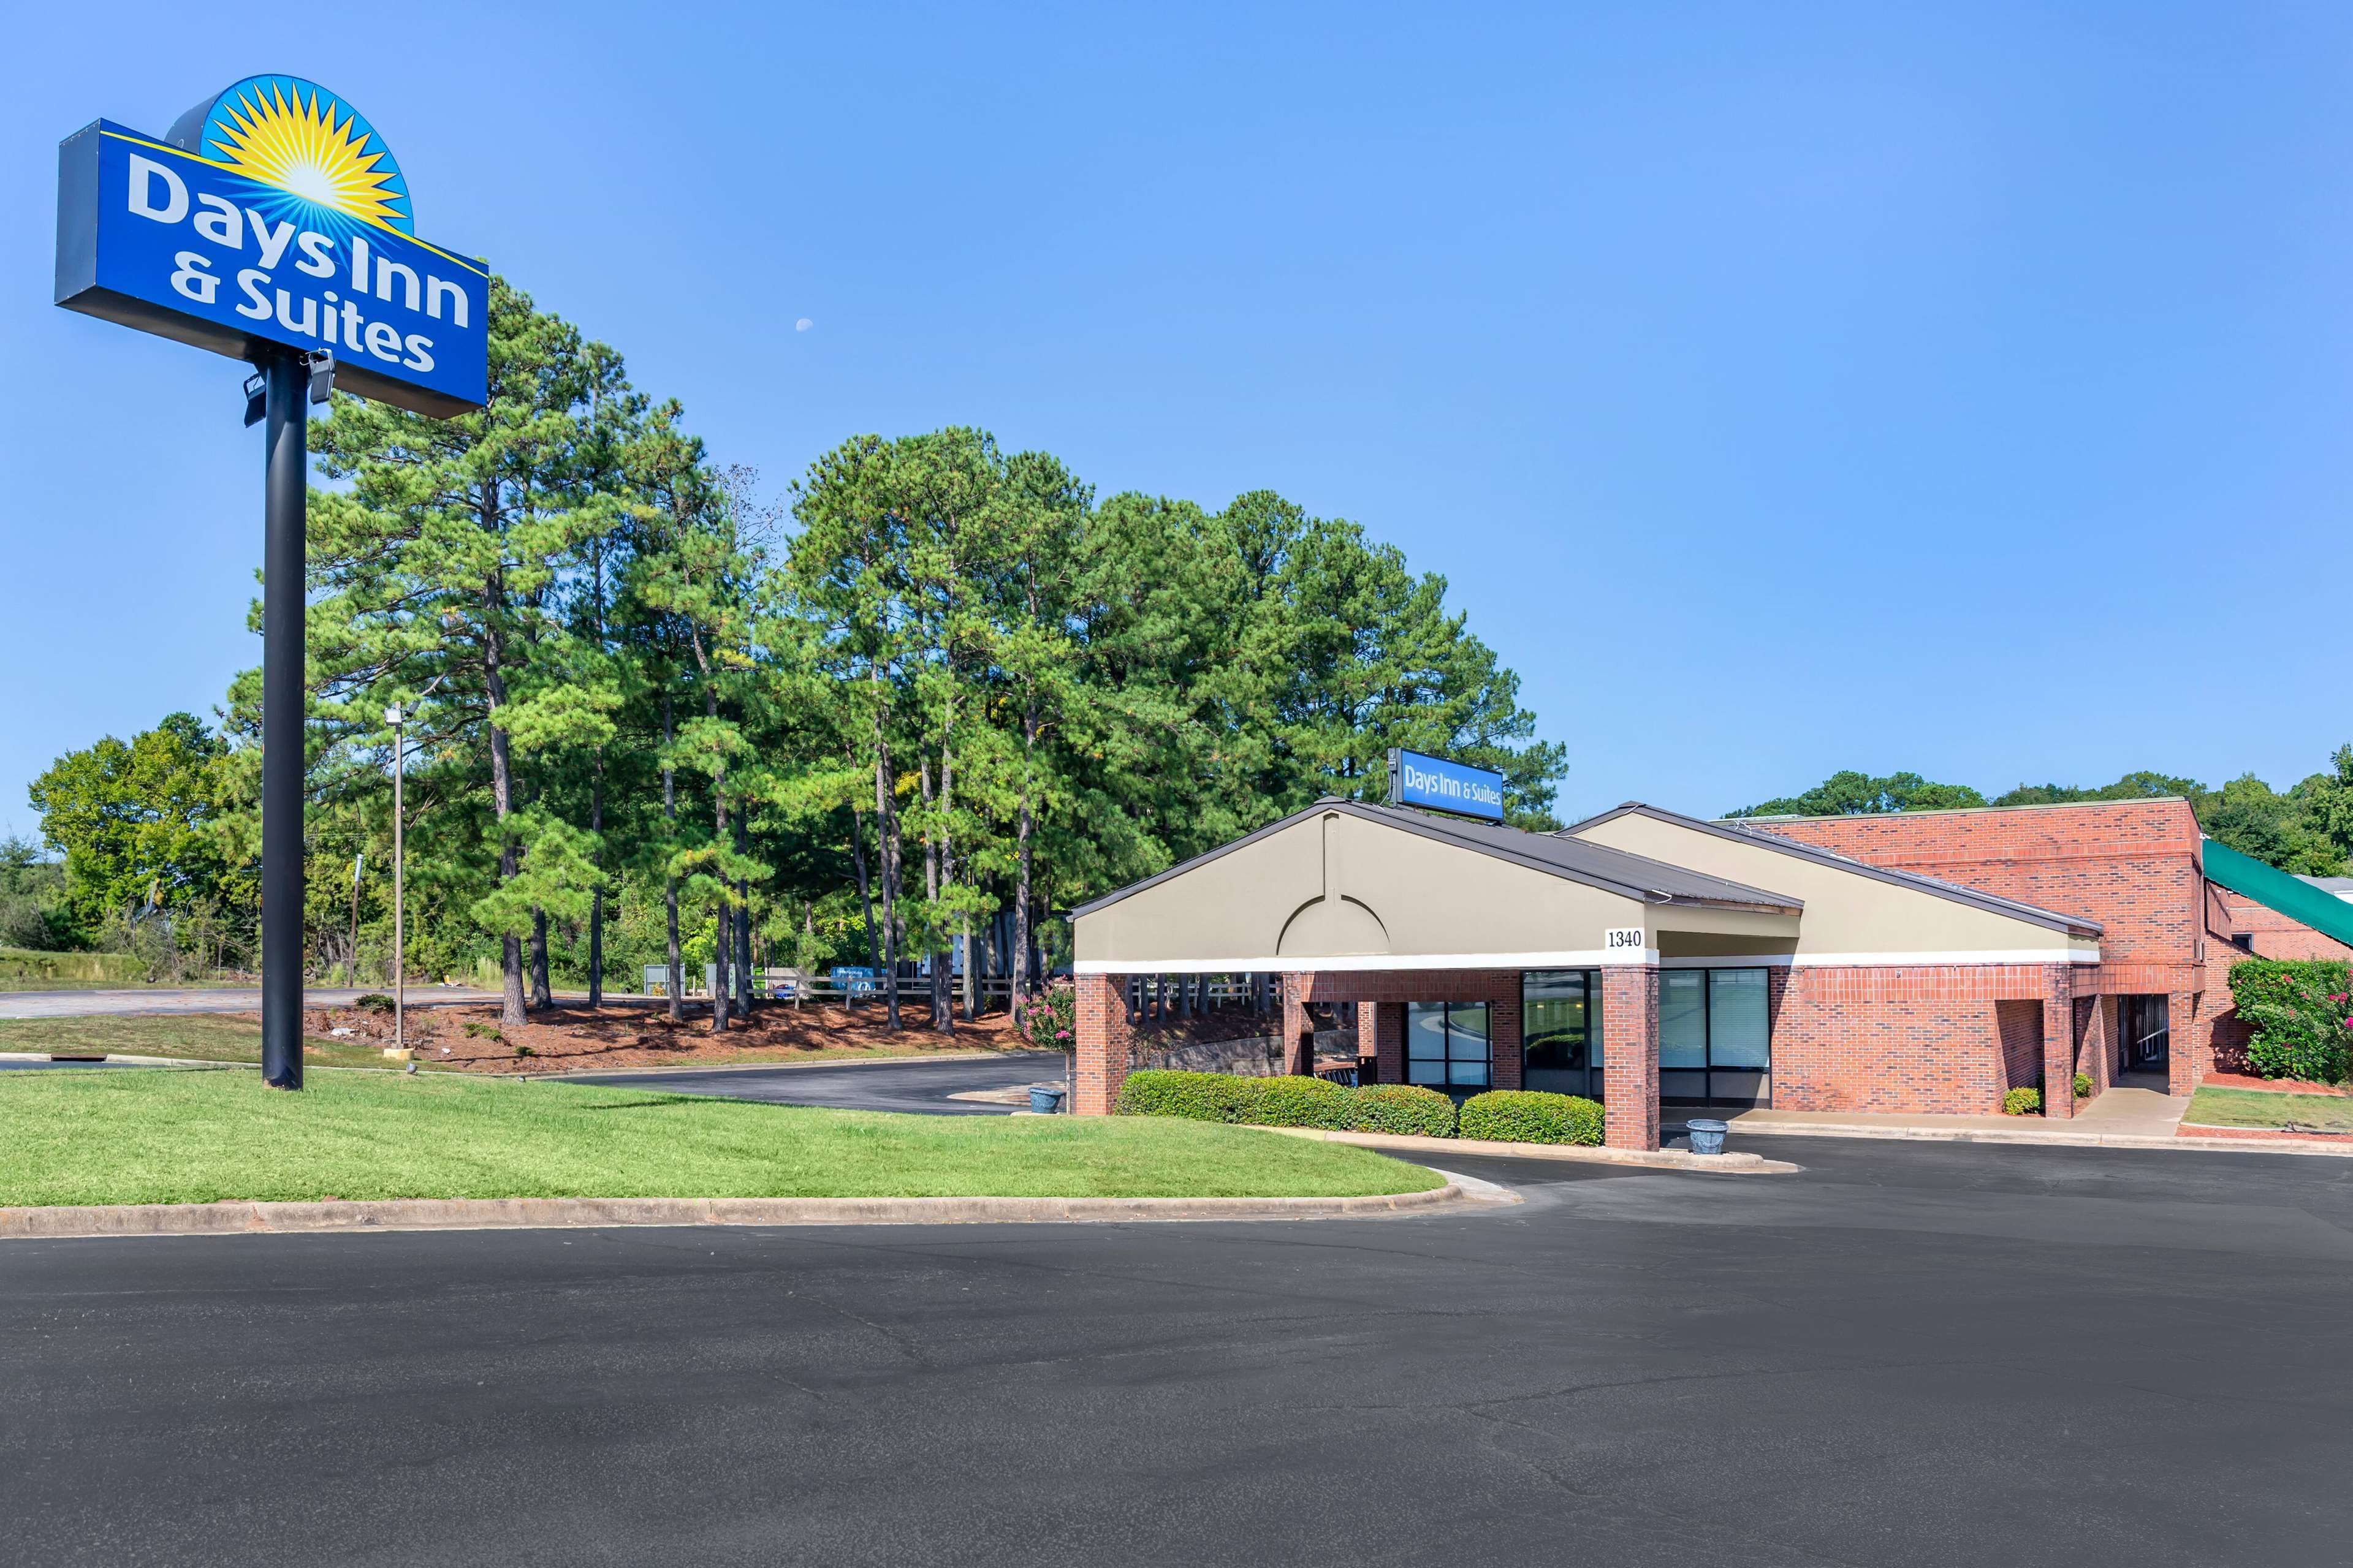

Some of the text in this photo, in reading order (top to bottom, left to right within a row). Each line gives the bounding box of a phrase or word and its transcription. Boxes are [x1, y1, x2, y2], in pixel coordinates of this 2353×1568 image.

[128, 153, 468, 327] Days Inn
[170, 251, 435, 373] & Suites
[1405, 765, 1501, 806] Days Inn & Suites
[1609, 930, 1641, 947] 1340
